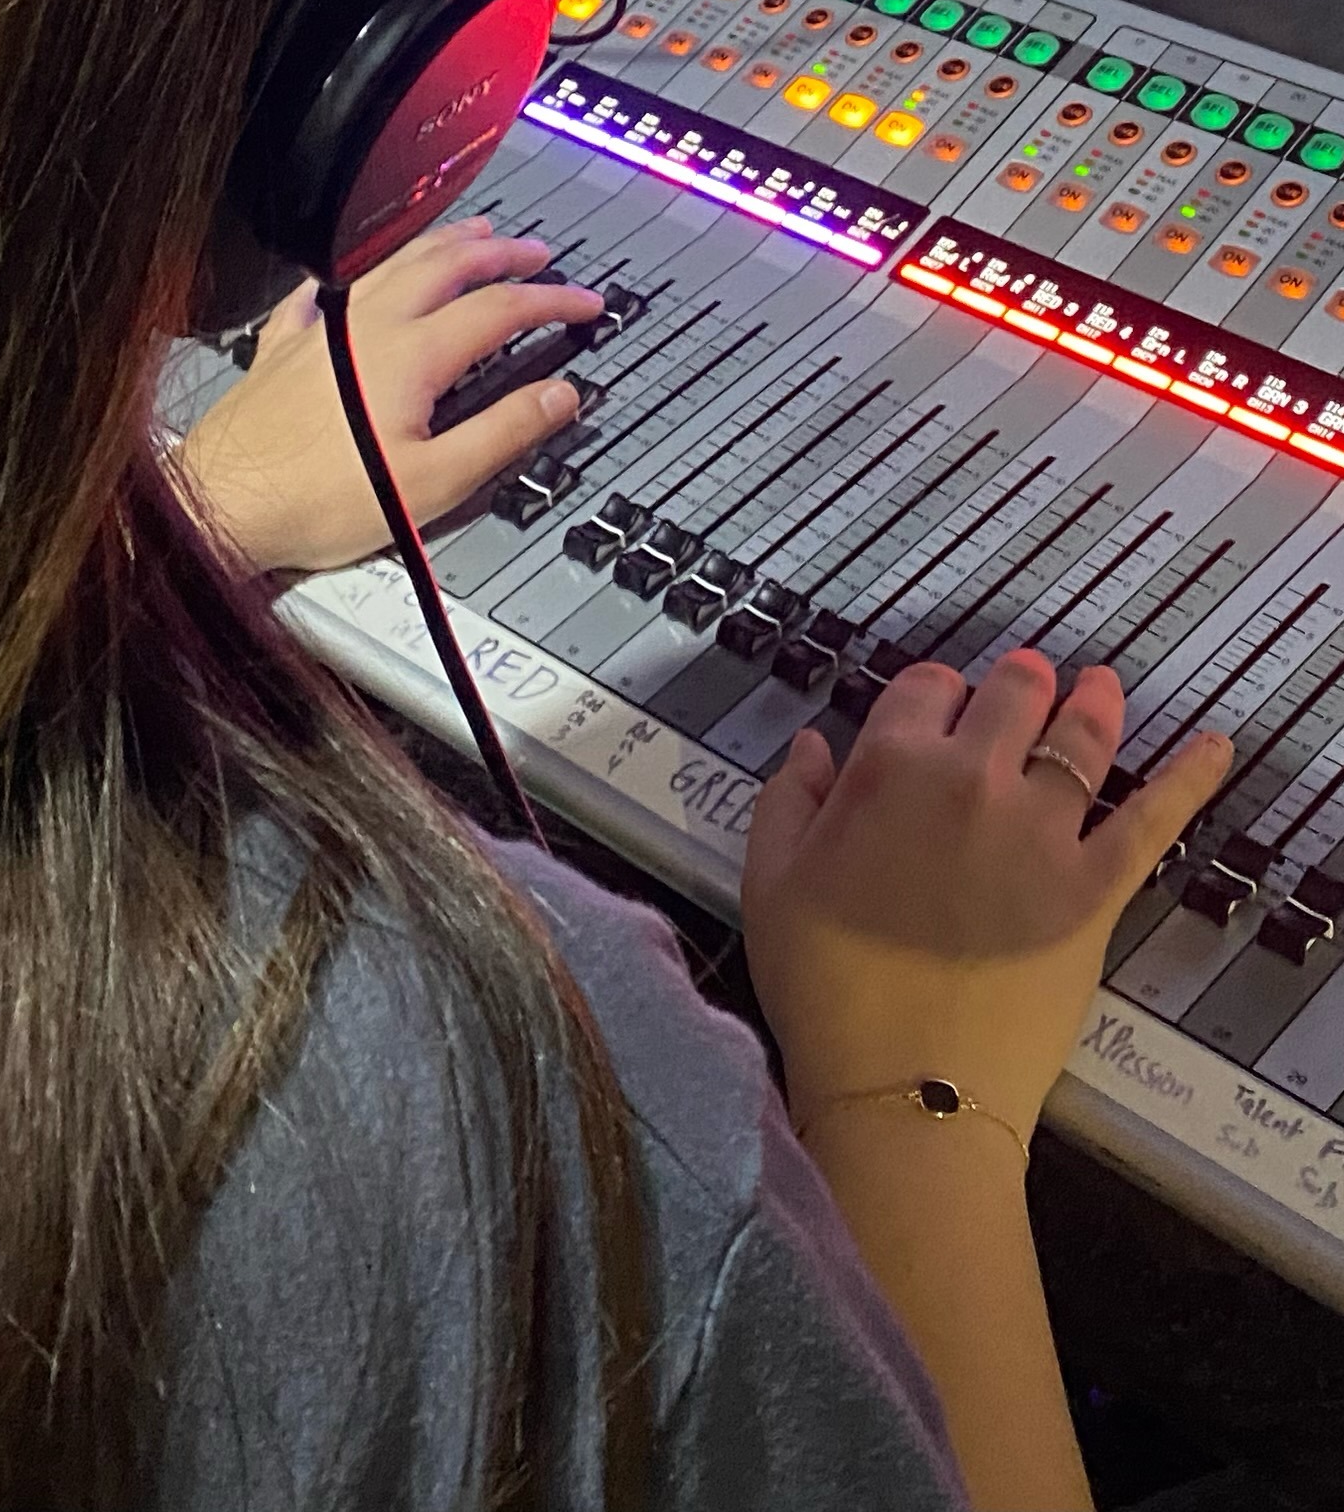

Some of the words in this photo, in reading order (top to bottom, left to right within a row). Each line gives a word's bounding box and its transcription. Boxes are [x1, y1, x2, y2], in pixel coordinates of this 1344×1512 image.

[1007, 169, 1030, 180] ON
[1059, 188, 1082, 201] ON
[1112, 210, 1135, 221] ON
[1165, 230, 1189, 244] ON
[1222, 250, 1247, 266] ON
[1279, 274, 1304, 288] ON
[1231, 373, 1249, 390] R
[1256, 386, 1292, 408] GRN
[465, 636, 560, 701] RED
